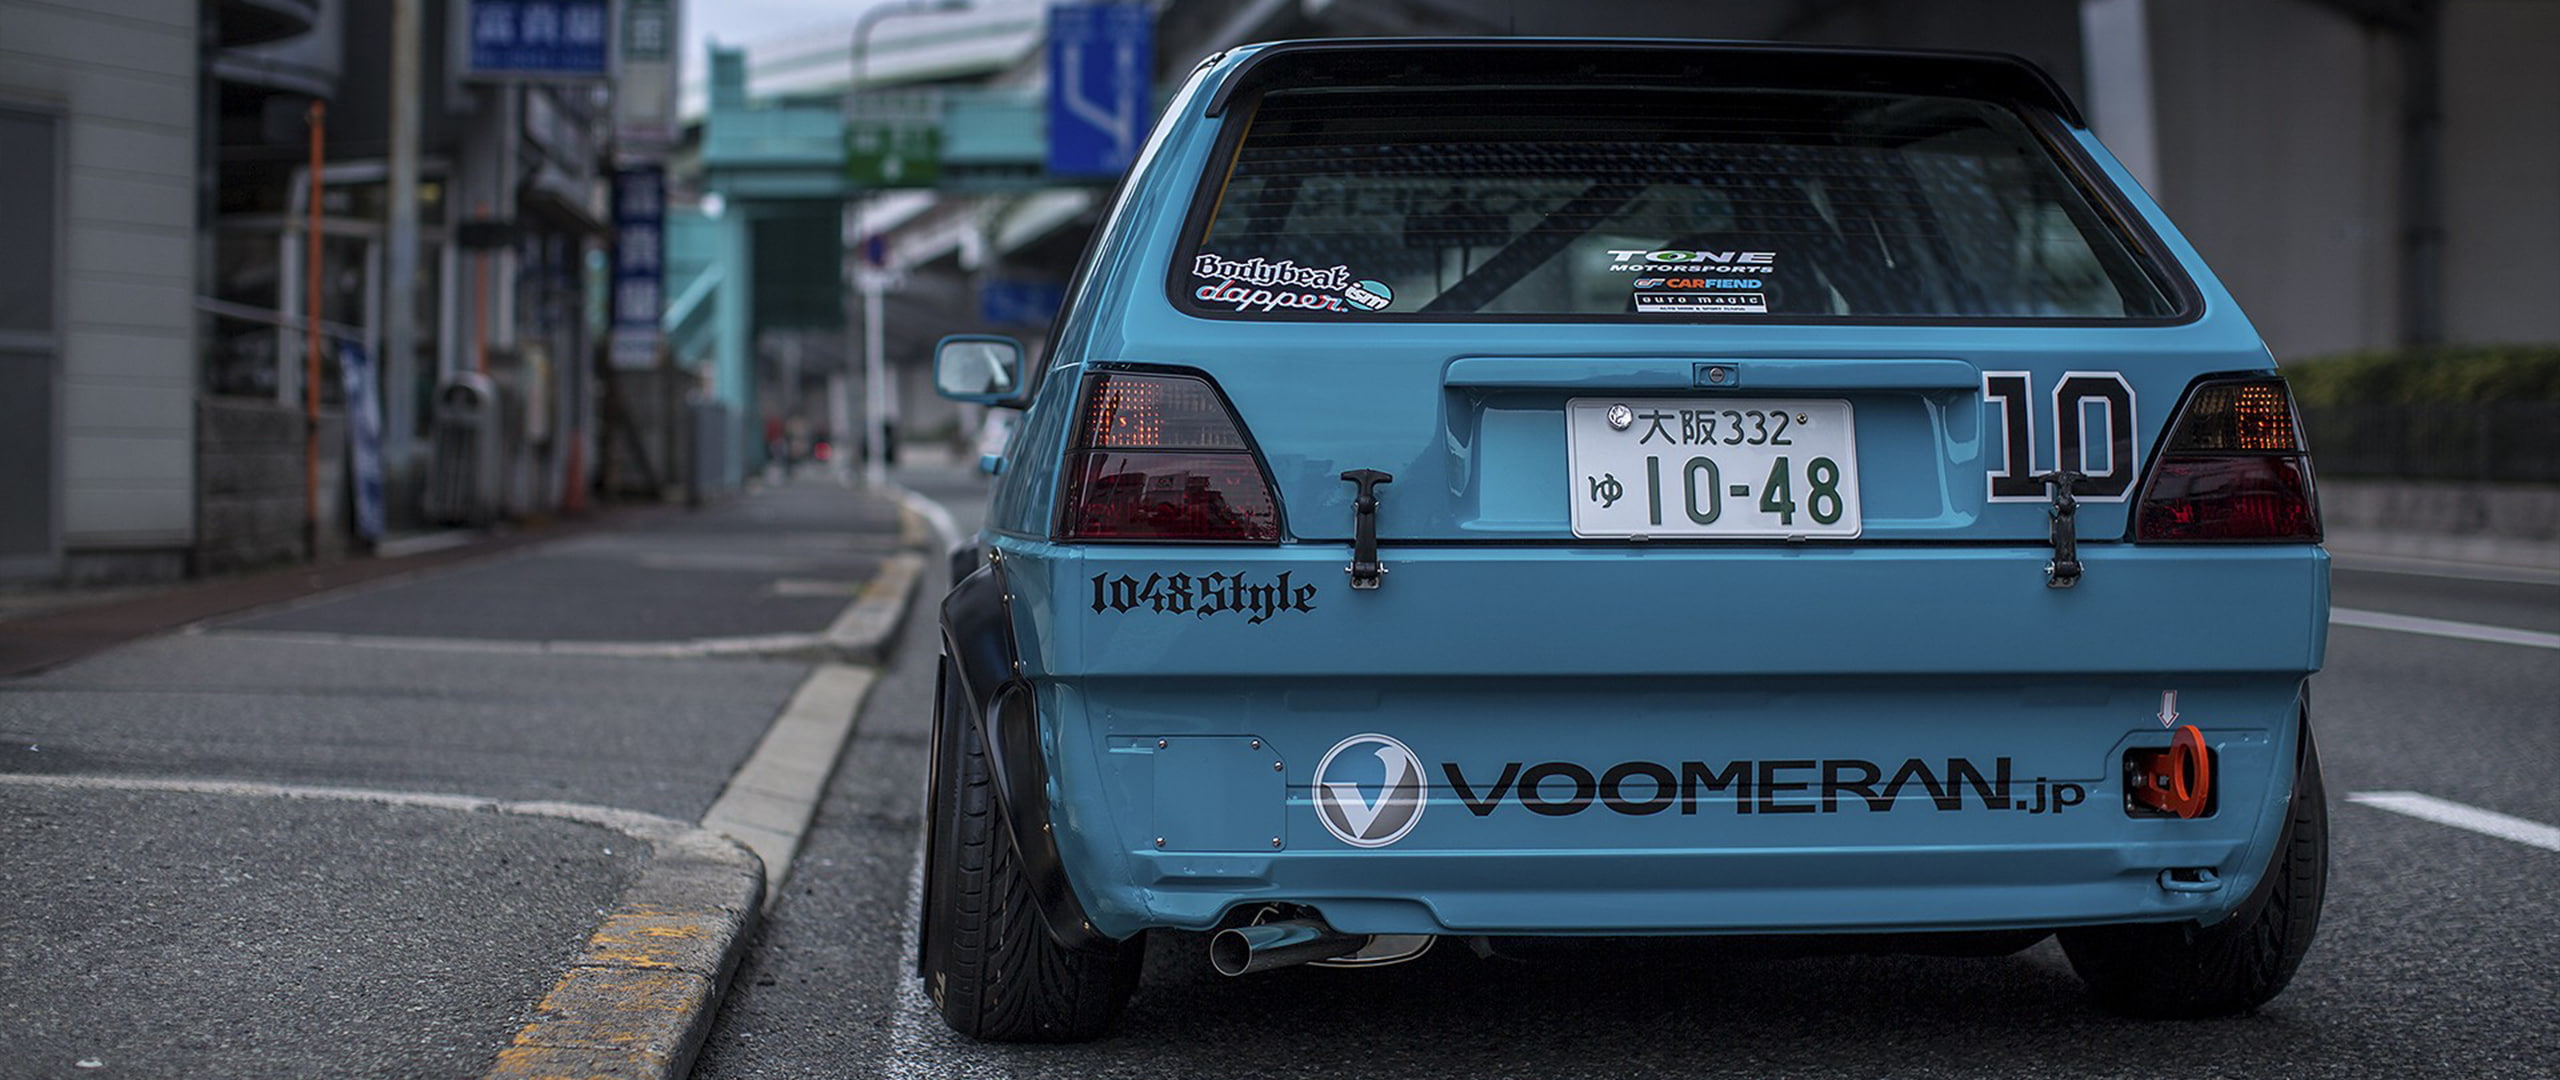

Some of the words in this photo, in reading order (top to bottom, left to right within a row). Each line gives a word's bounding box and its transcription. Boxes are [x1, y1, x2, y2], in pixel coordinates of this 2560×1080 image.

[1607, 250, 1776, 264] TONE
[1610, 264, 1773, 274] MOTORSPORTS
[1193, 254, 1350, 291] Bodybeat
[1666, 278, 1762, 289] CARFIEND
[1642, 296, 1687, 304] euro
[1698, 296, 1758, 304] magic
[1983, 371, 2139, 503] 10
[1588, 473, 1623, 508] ゆ
[1646, 456, 1843, 525] 10-48
[1091, 570, 1318, 625] 1048Style
